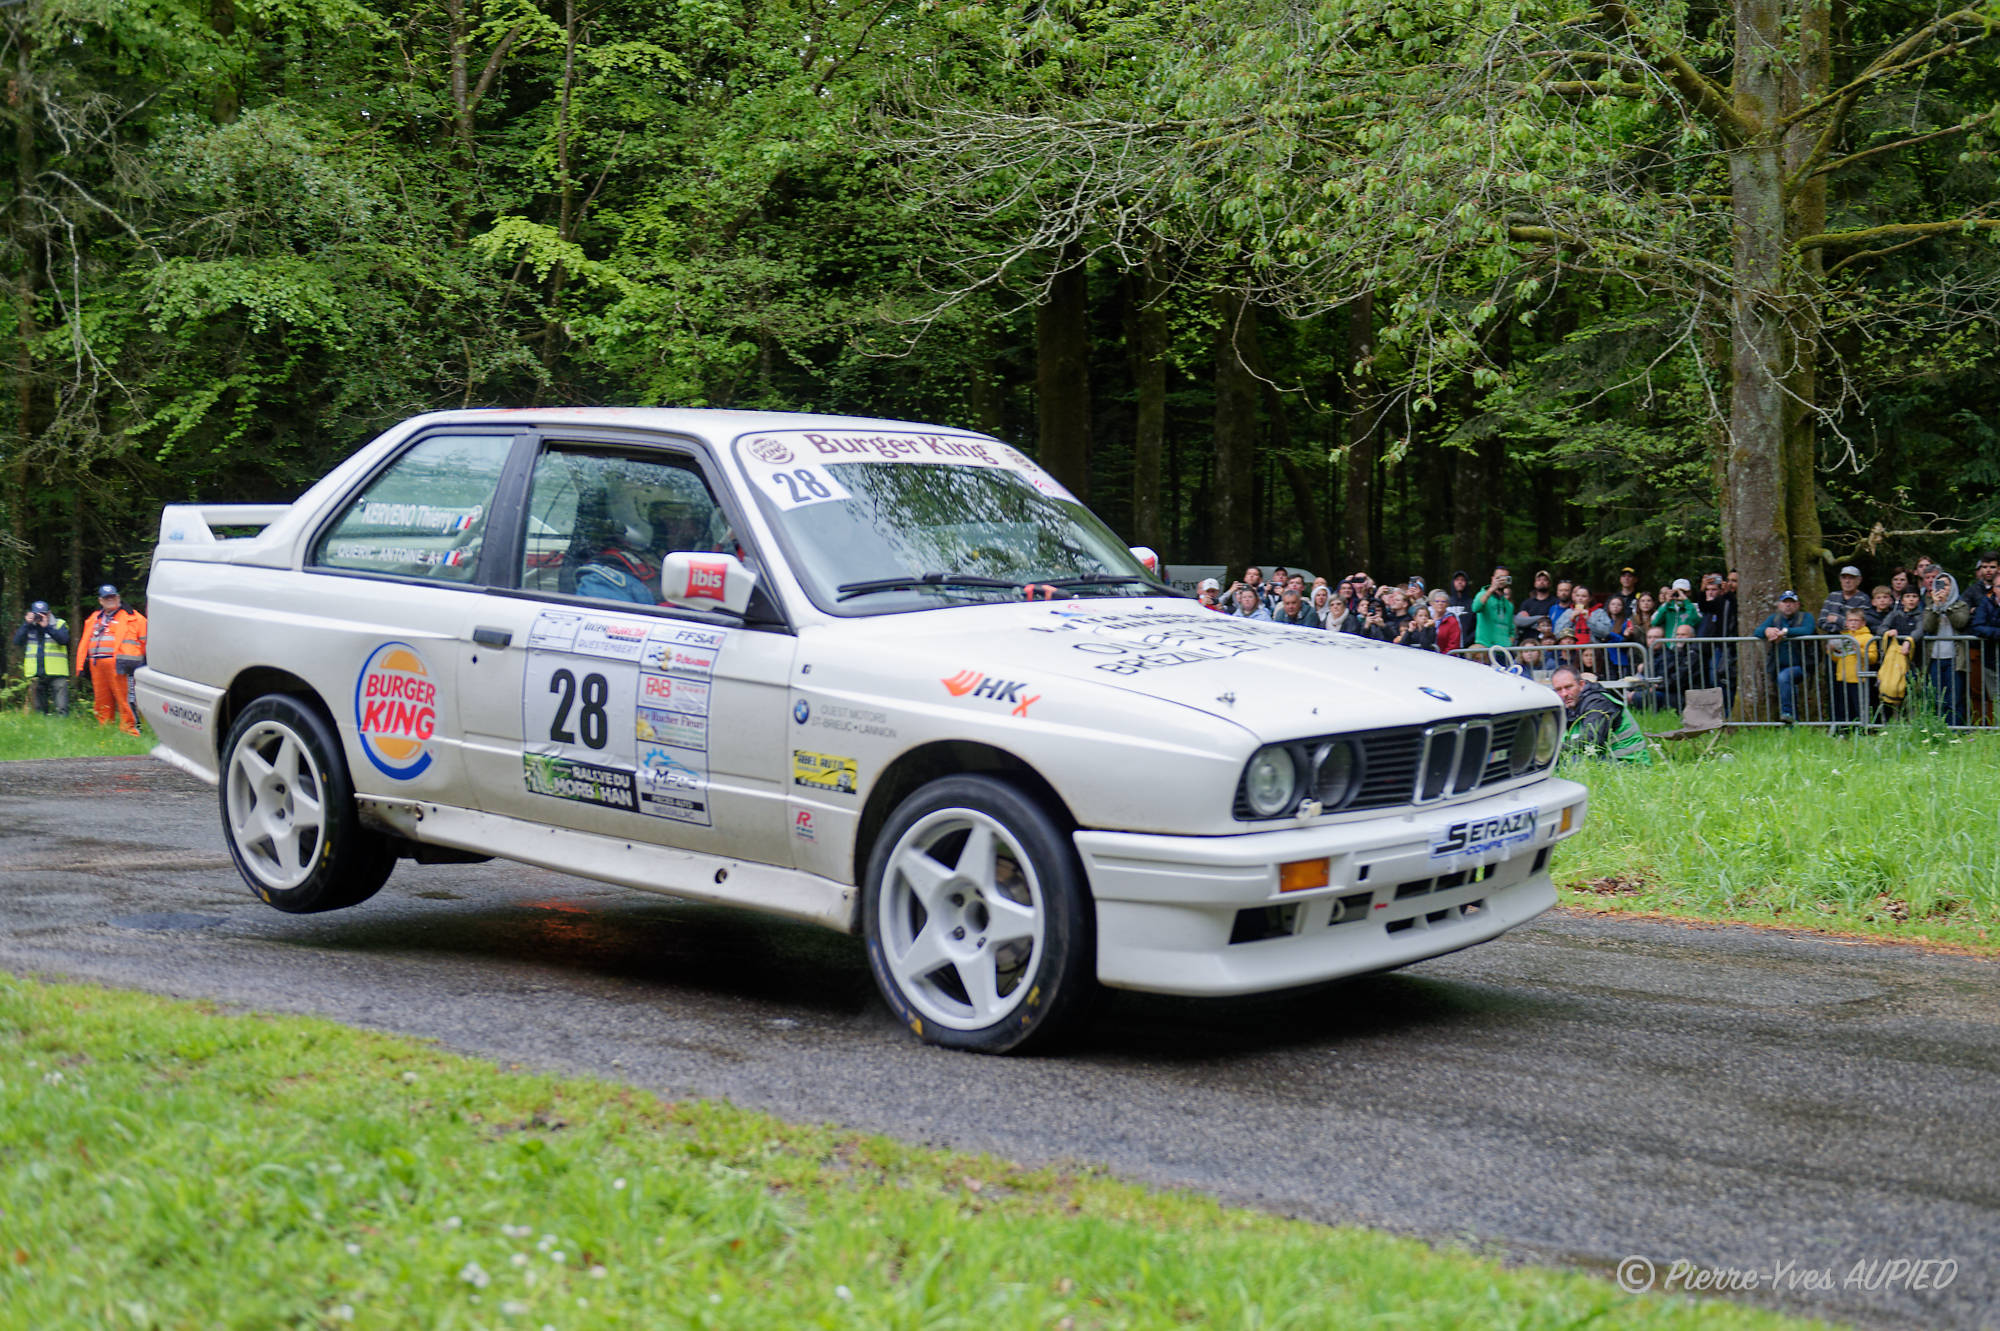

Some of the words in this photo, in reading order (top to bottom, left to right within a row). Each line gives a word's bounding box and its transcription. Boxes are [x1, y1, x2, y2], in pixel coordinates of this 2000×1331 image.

[803, 434, 920, 459] Burger
[917, 436, 999, 465] King
[772, 469, 831, 503] 28
[692, 568, 722, 588] ibis
[675, 630, 714, 645] FFSA
[365, 673, 436, 707] BURGER
[361, 699, 436, 740] KING
[550, 668, 608, 750] 28
